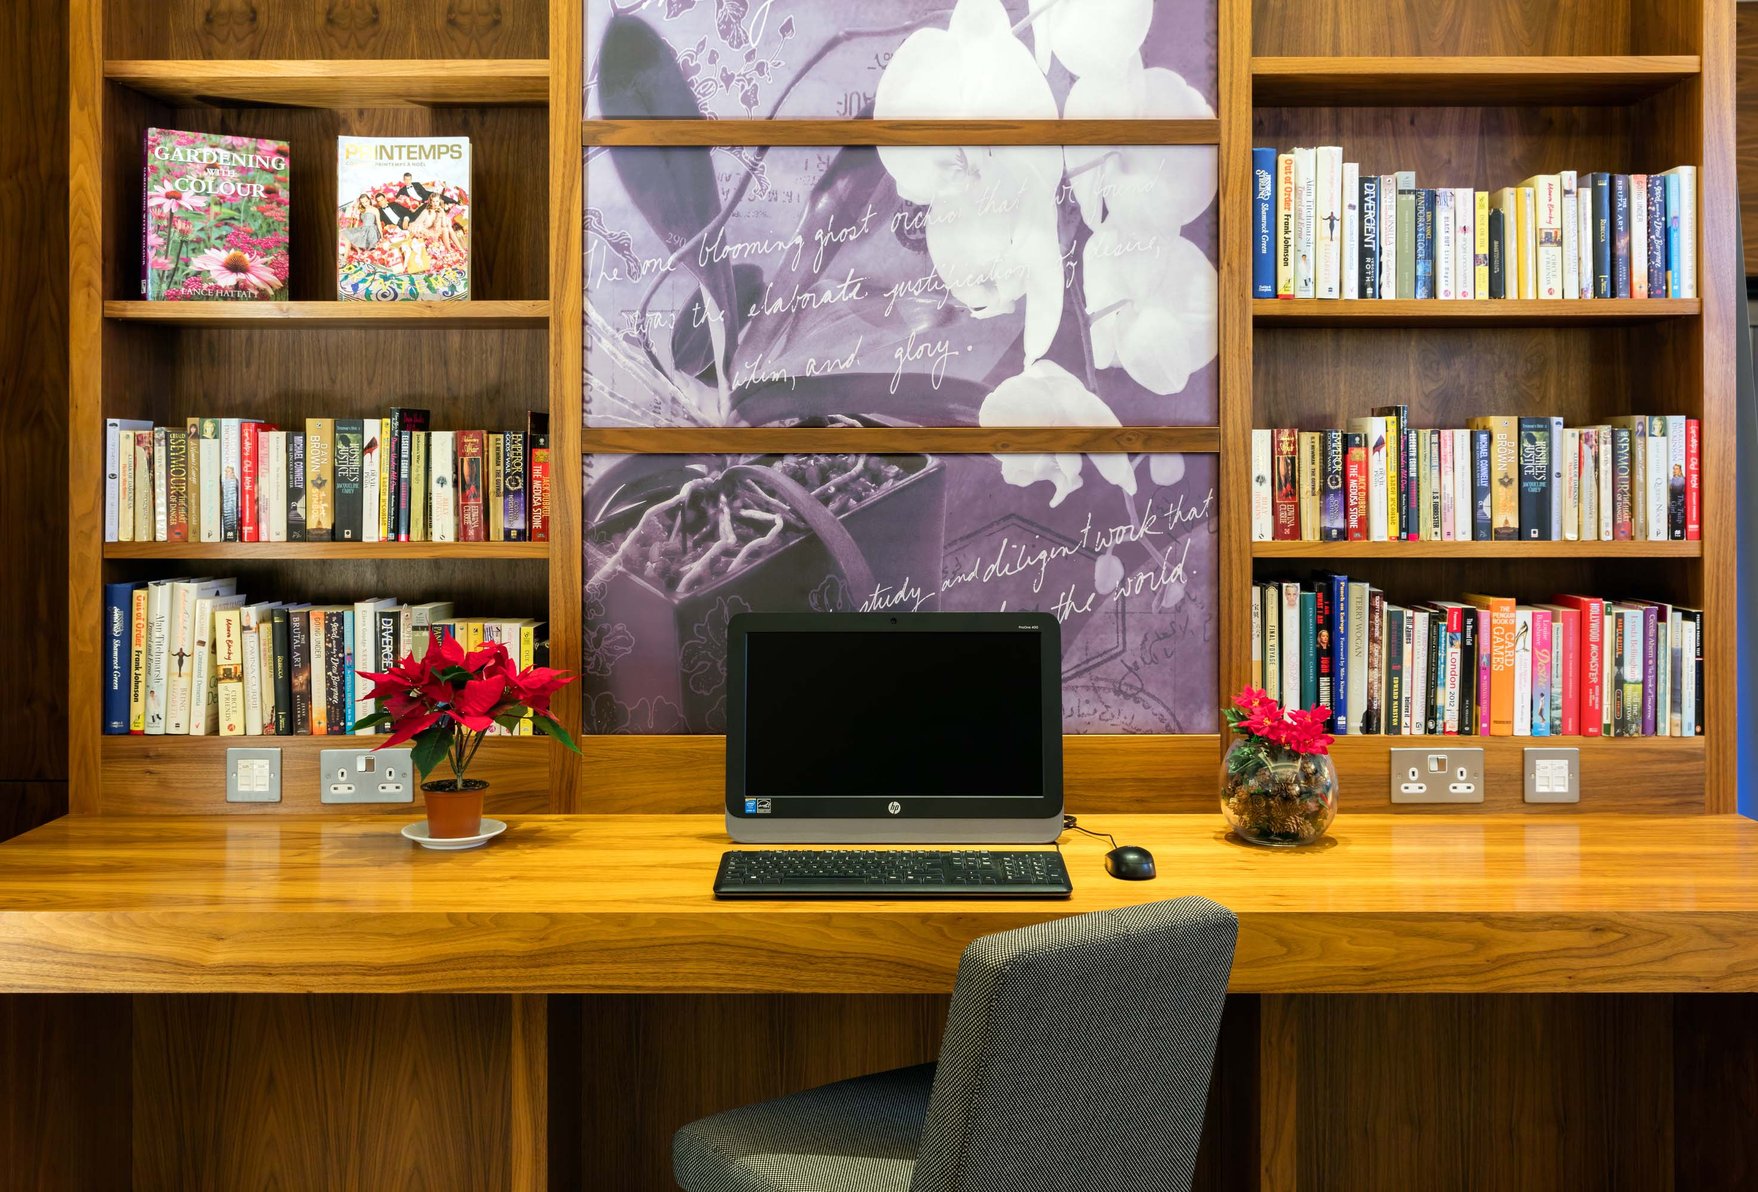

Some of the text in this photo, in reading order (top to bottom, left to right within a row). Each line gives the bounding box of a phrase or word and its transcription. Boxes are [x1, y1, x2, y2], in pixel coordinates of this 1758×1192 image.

[154, 146, 286, 171] GARDENING
[345, 144, 463, 161] PRINTEMPS
[174, 178, 268, 199] COLOUR
[206, 168, 236, 178] WITH
[1284, 159, 1294, 211] Out of Order
[1364, 183, 1376, 251] DIVERGENT
[1636, 180, 1644, 223] GOING UNDER
[670, 231, 692, 254] 290
[1261, 203, 1269, 254] Shamrock Green
[1283, 214, 1293, 267] Frank Johnson
[1306, 199, 1315, 248] Titchmarsh
[584, 238, 630, 290] The
[641, 253, 683, 277] one
[703, 226, 806, 273] blooming
[813, 204, 877, 273] ghost
[181, 288, 213, 299] LANCE
[692, 296, 726, 334] the
[805, 335, 862, 377] and
[169, 439, 187, 493] SEYMOUR
[294, 436, 304, 489] MICHAEL CONNELLY
[311, 435, 321, 473] BROWN
[337, 447, 349, 478] JUSTICE
[346, 443, 360, 482] KUSHIEL'S
[511, 433, 523, 475] EMPEROR
[1331, 432, 1343, 474] EMPEROR
[1479, 434, 1489, 487] MICHAEL CONNELLY
[1497, 433, 1507, 472] BROWN
[1507, 441, 1515, 463] DAN
[1522, 445, 1535, 476] JUSTICE
[1533, 441, 1547, 481] KUSHIEL'S
[1616, 437, 1630, 493] SEYMOUR
[170, 503, 178, 526] DANGER
[178, 507, 186, 523] HEART
[533, 465, 542, 529] THE MEDUSA STONE
[542, 476, 550, 518] JACK DUBRUL
[1279, 503, 1287, 525] CURRIE
[1350, 464, 1358, 529] THE MEDUSA STONE
[1358, 475, 1366, 517] JACK DUBRUL
[1670, 500, 1678, 514] Girl
[463, 505, 472, 526] CURRIE
[1287, 504, 1295, 528] EDWINA
[1432, 502, 1440, 529] FORRESTER
[860, 577, 936, 613] study
[941, 557, 981, 592] and
[1094, 499, 1164, 562] work
[1165, 488, 1213, 529] that
[1050, 588, 1097, 625] the
[1589, 603, 1600, 642] HOLLYWOOD
[1648, 613, 1656, 636] Cecelia
[135, 623, 145, 648] Order
[292, 616, 302, 668] BRUTAL ART
[314, 617, 322, 637] GOING
[1355, 595, 1363, 658] TERRY WOGAN
[1405, 616, 1413, 644] Bill James
[1535, 614, 1543, 646] Bagshawe
[1542, 619, 1550, 640] Louise
[112, 638, 121, 690] Shamrock Green
[154, 613, 165, 684] Alan Titchmarsh
[196, 651, 204, 678] Contented
[1492, 626, 1504, 671] GAMES
[1504, 632, 1515, 667] CARD
[1588, 644, 1599, 684] MONSTER
[1629, 640, 1639, 680] Bellingham
[1648, 637, 1656, 658] Ahern
[133, 650, 143, 703] Frank Johnson
[1449, 651, 1458, 689] London
[1535, 648, 1551, 688] Desire
[179, 687, 188, 711] BEING
[1632, 704, 1638, 715] me
[889, 801, 901, 815] hp
